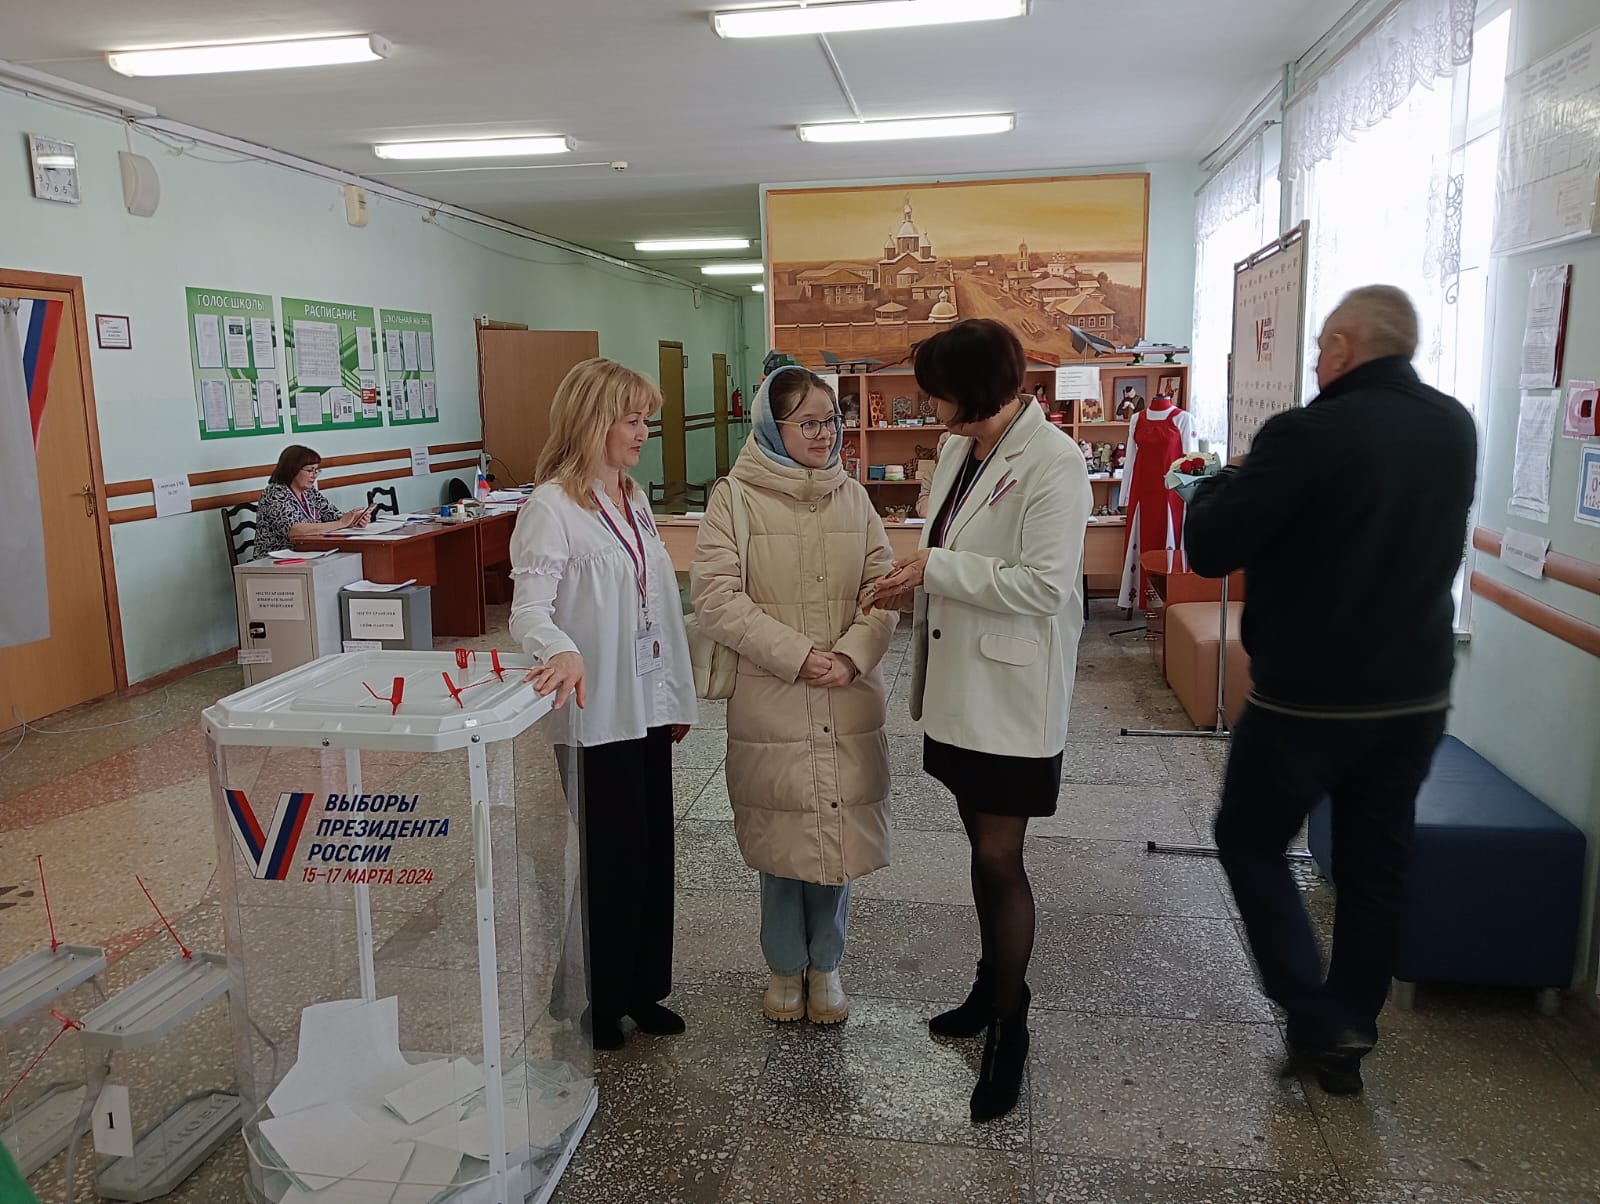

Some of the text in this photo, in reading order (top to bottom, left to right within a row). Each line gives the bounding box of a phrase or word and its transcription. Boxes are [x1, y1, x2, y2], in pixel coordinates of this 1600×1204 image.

[197, 294, 265, 311] ГОЛОС ШКОЛЫ
[304, 304, 357, 321] РАСПИСАНИЕ
[324, 793, 419, 813] ВЫБОРЫ
[316, 818, 450, 840] ПРЕЗИДЕНТА
[307, 843, 392, 863] РОССИИ
[342, 868, 394, 885] МАРТА
[396, 868, 434, 885] 2024
[106, 1111, 116, 1129] 1
